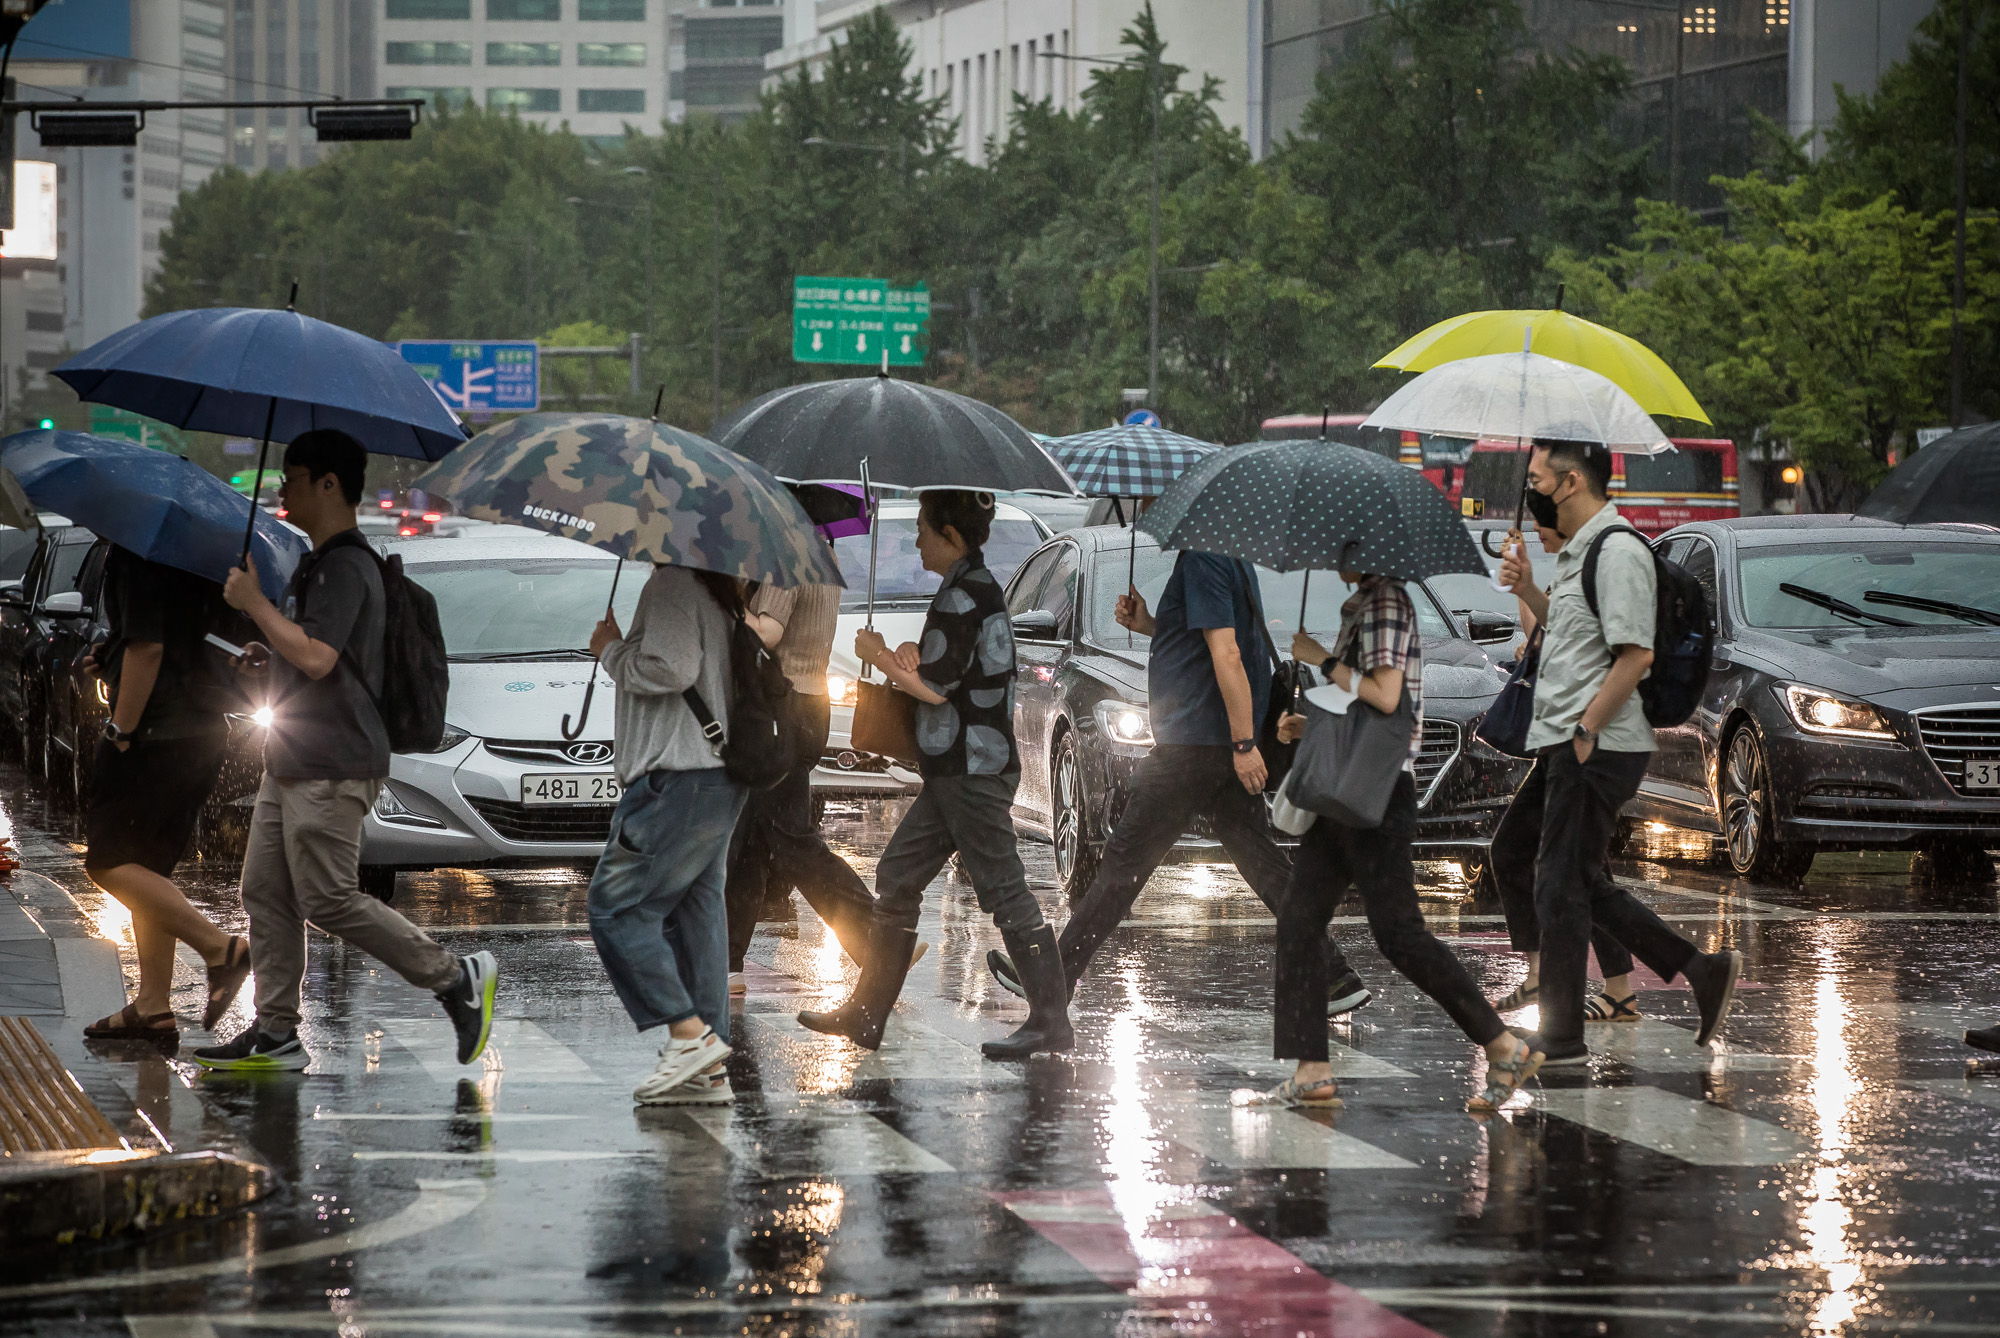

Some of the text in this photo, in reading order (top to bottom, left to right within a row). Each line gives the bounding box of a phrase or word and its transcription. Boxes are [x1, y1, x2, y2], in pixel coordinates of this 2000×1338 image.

[522, 505, 596, 532] BUCKAROO
[1977, 764, 2000, 785] 31
[535, 778, 623, 799] 48고 25
